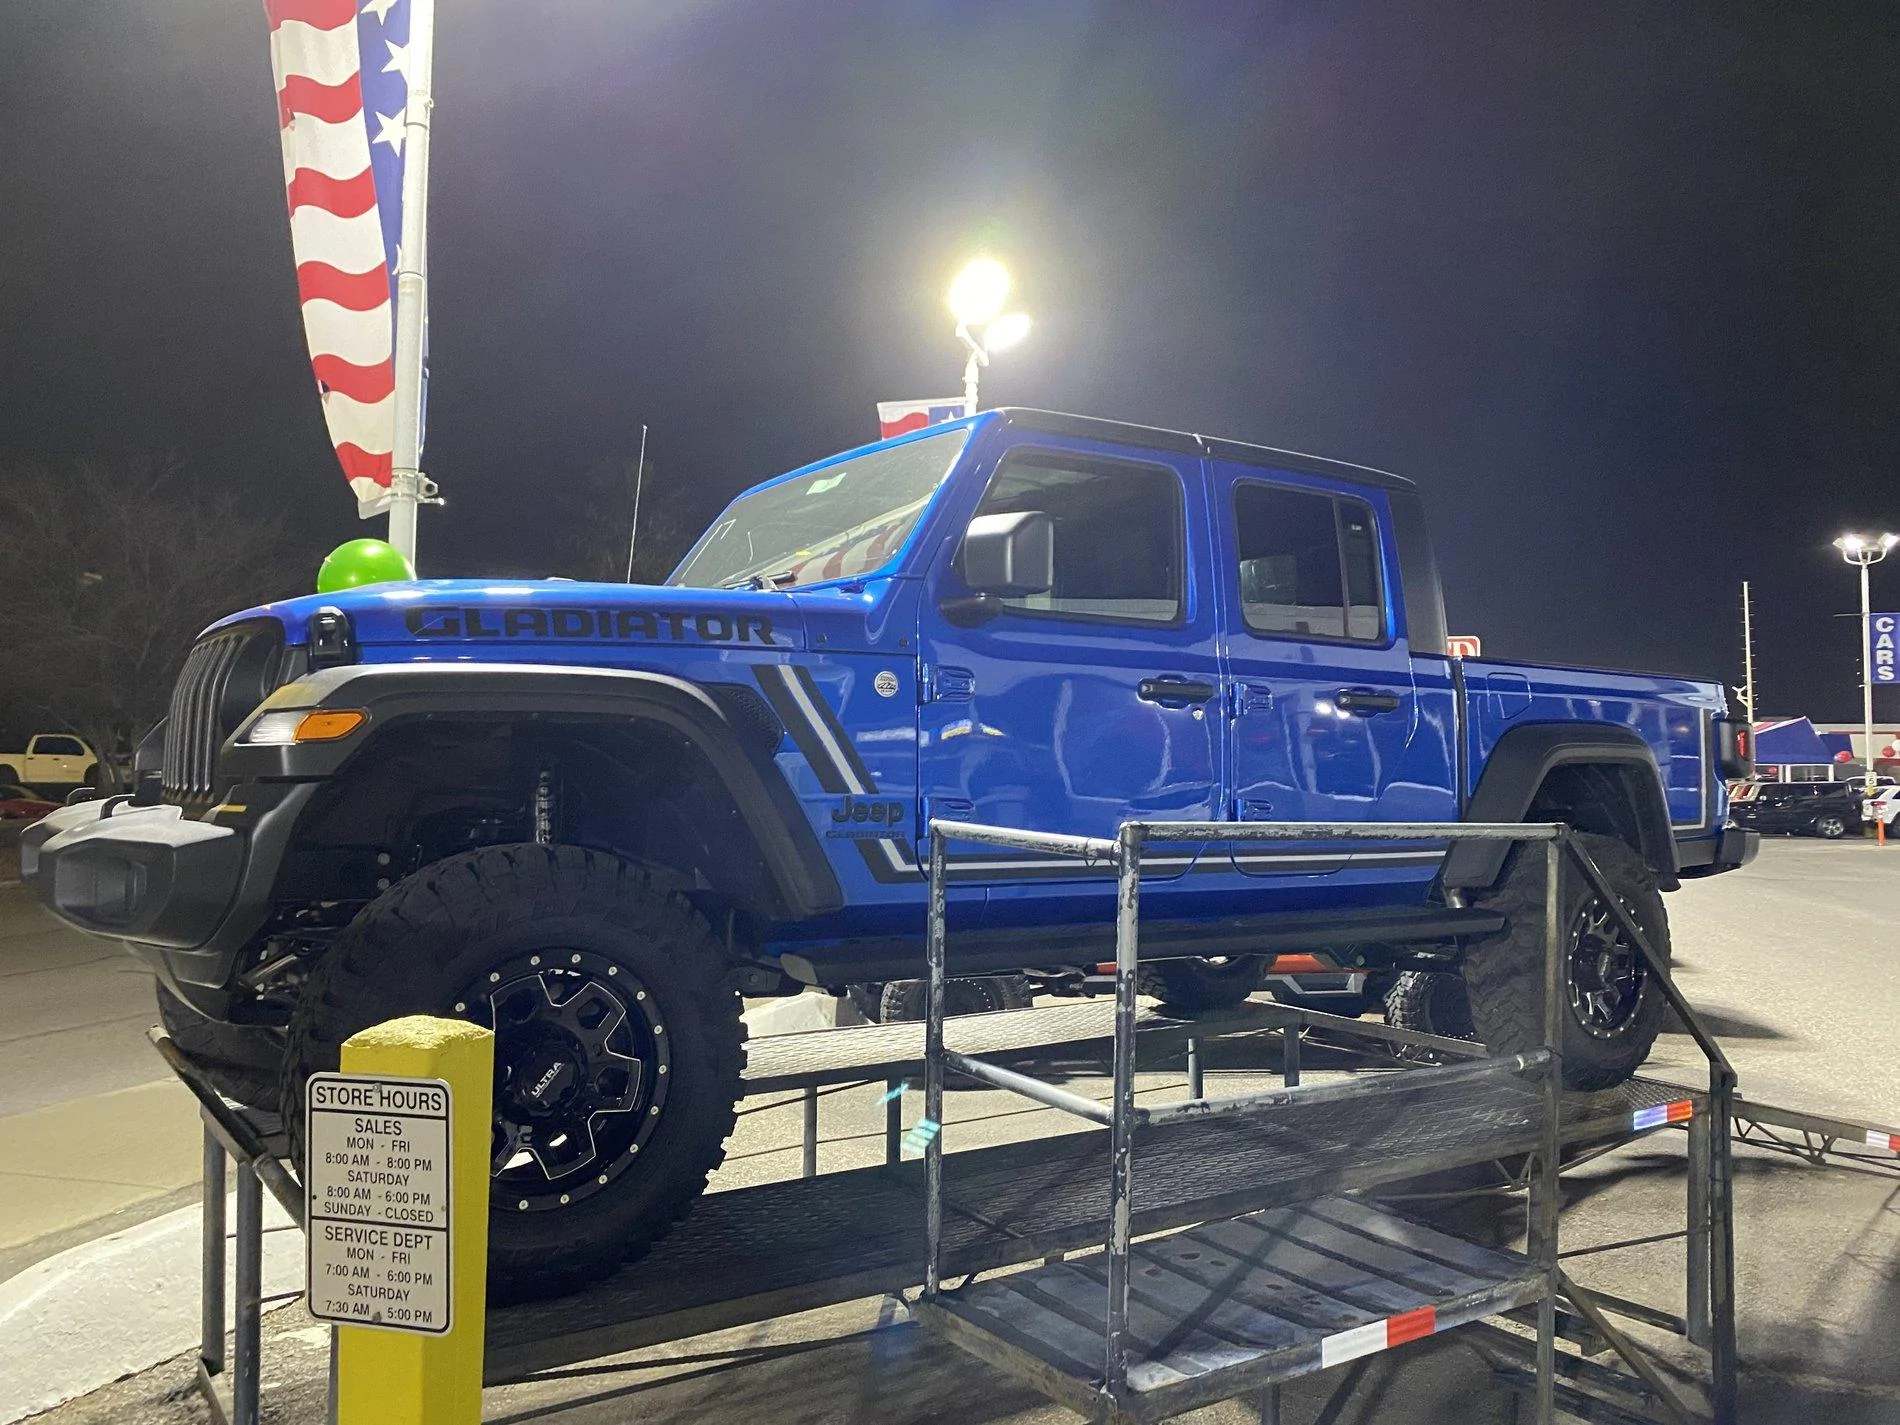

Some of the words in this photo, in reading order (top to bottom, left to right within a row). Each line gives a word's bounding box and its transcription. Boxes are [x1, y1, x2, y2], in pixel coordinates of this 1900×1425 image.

[405, 605, 776, 645] GLADIATOR
[1875, 616, 1895, 681] CARS
[831, 795, 905, 827] Jeep
[531, 1062, 562, 1096] ULTRA
[316, 1086, 374, 1107] STORE
[379, 1090, 442, 1111] HOURS
[354, 1117, 402, 1136] SALES
[346, 1137, 374, 1150] MON
[391, 1140, 410, 1153] FRI
[325, 1152, 349, 1165] 8:00
[351, 1154, 370, 1166] AM
[387, 1157, 411, 1170] 8:00
[414, 1159, 432, 1171] PM
[347, 1169, 410, 1187] SATURDAY
[326, 1185, 350, 1199] 8:00
[353, 1187, 371, 1200] AM
[385, 1190, 409, 1204] 6:00
[412, 1192, 431, 1206] PM
[324, 1201, 372, 1217] SUNDAY
[385, 1206, 434, 1223] CLOSED
[324, 1225, 388, 1246] SERVICE
[393, 1232, 433, 1250] DEPT
[346, 1247, 374, 1260] MON
[391, 1251, 411, 1265] FRI
[325, 1264, 349, 1277] 7:00
[352, 1266, 370, 1279] AM
[387, 1270, 411, 1283] 6:00
[414, 1272, 433, 1286] PM
[347, 1283, 410, 1302] SATURDAY
[325, 1300, 349, 1313] 7:30
[352, 1302, 370, 1316] AM
[387, 1307, 411, 1320] 5:00
[414, 1310, 433, 1323] PM
